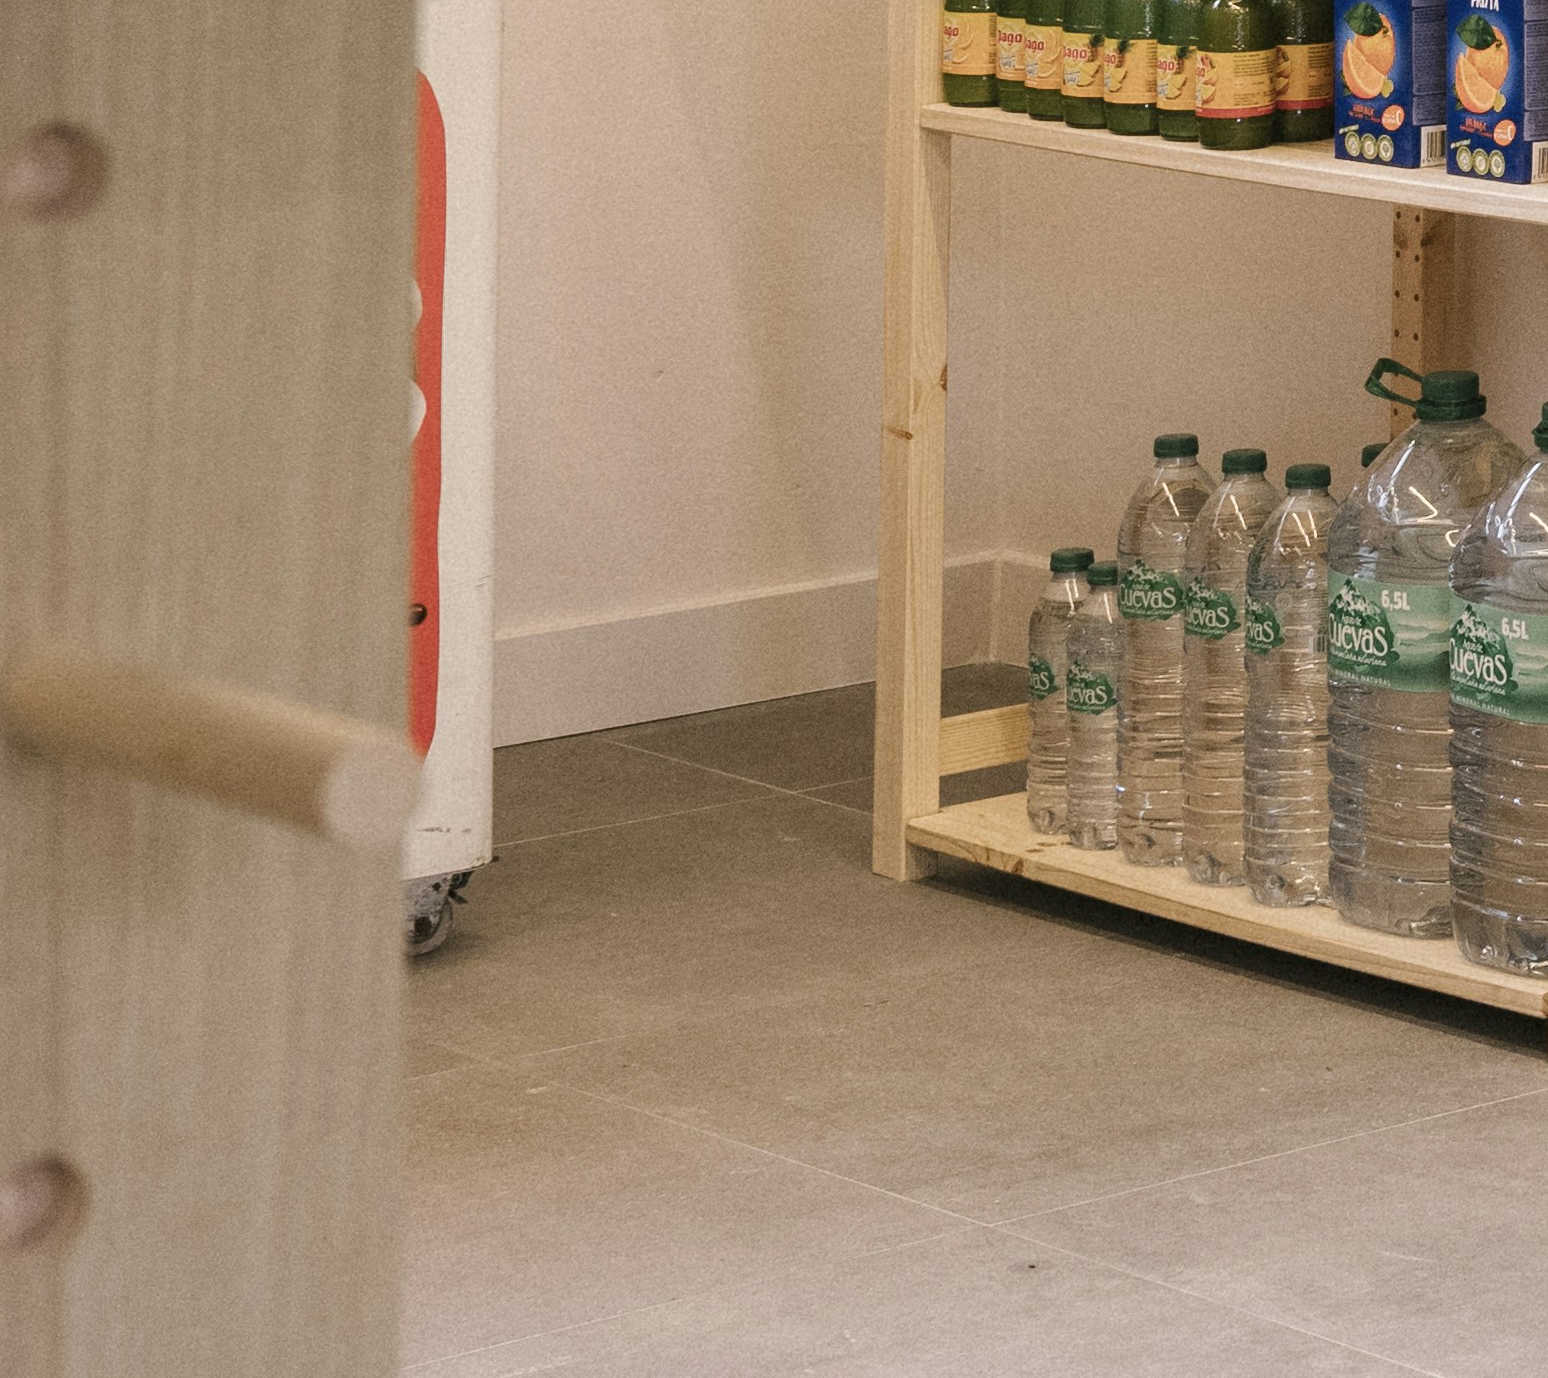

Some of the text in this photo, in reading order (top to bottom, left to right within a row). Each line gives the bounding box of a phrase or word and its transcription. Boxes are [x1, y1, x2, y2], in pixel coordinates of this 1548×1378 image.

[1119, 583, 1176, 609] Cuevas
[1381, 589, 1410, 611] 6,5L
[1329, 612, 1388, 657] Cuevas
[1501, 617, 1529, 640] 6,5L
[1449, 637, 1508, 686] Cuevas
